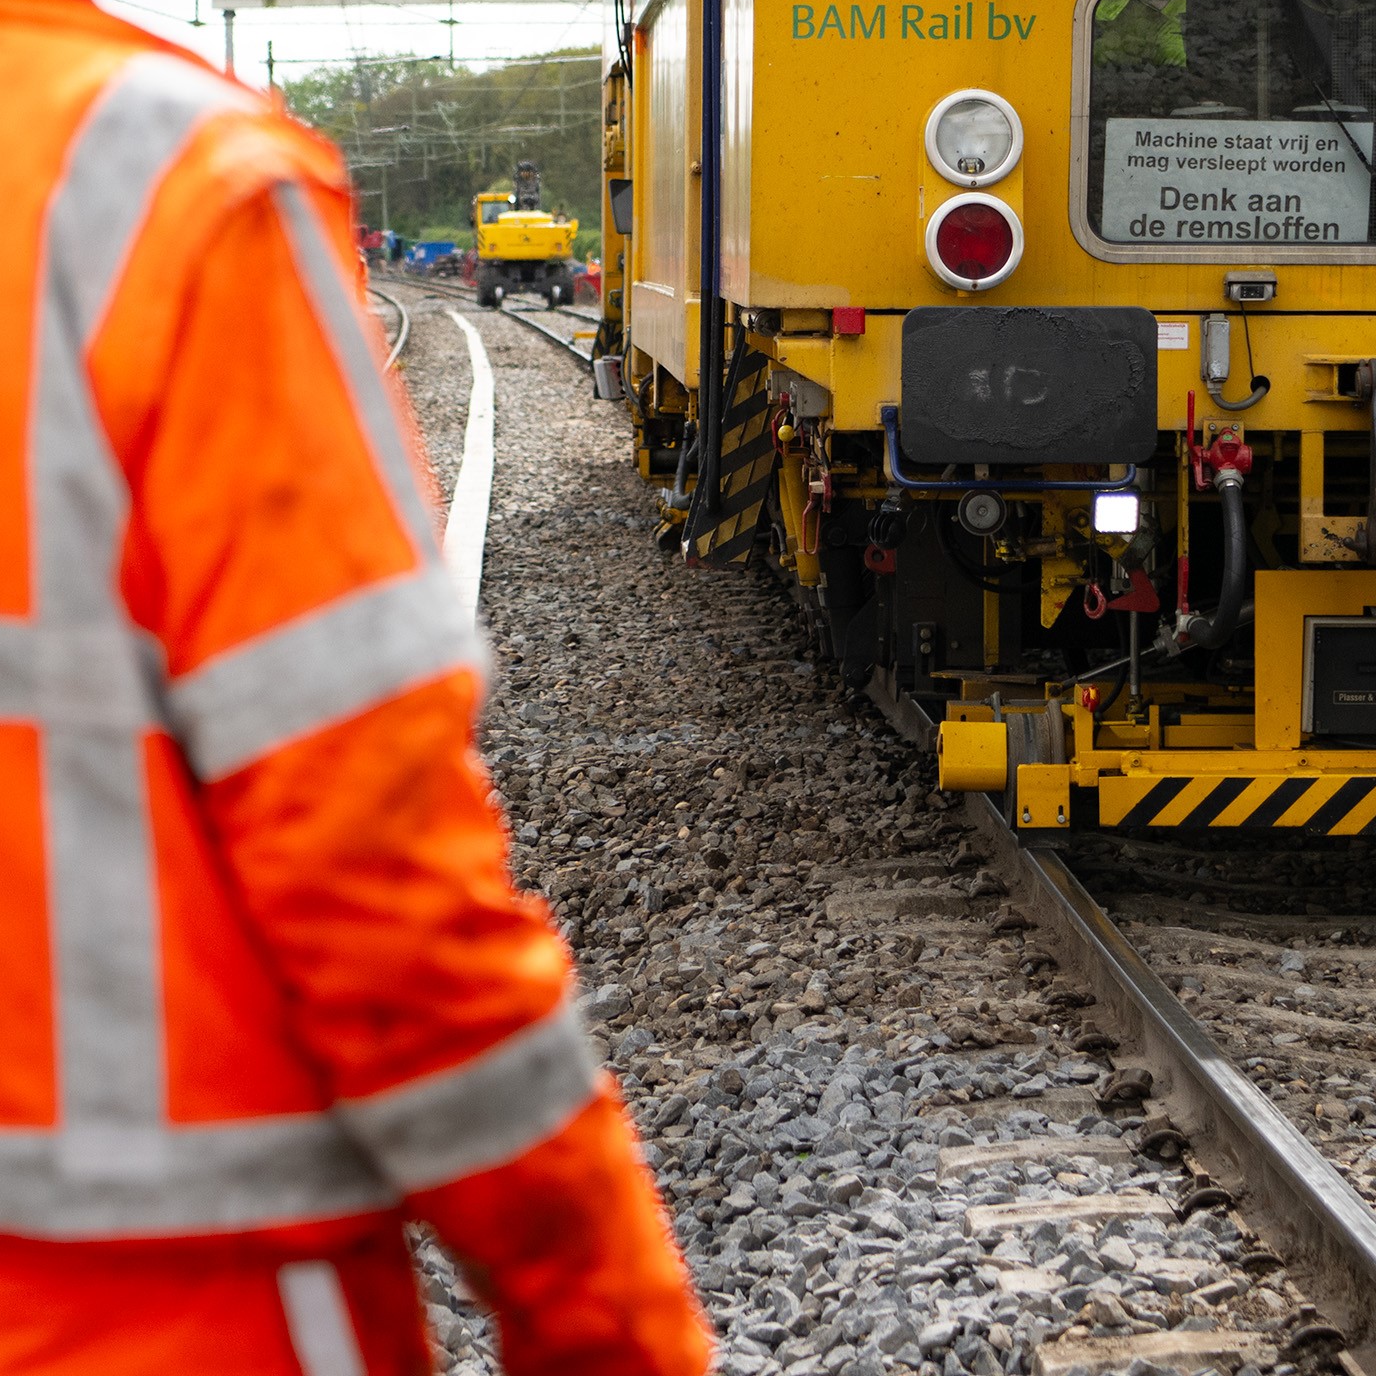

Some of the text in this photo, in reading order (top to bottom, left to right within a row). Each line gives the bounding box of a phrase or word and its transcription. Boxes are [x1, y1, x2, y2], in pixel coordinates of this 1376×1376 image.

[791, 2, 1037, 41] BAM Rail bv
[1135, 131, 1339, 154] Machine staat vrij en
[1127, 154, 1346, 174] mag versleept worden
[1160, 186, 1301, 213] Denk aan
[1129, 213, 1340, 240] de remsloffen
[1338, 693, 1365, 702] Plasser
[1368, 693, 1374, 702] &
